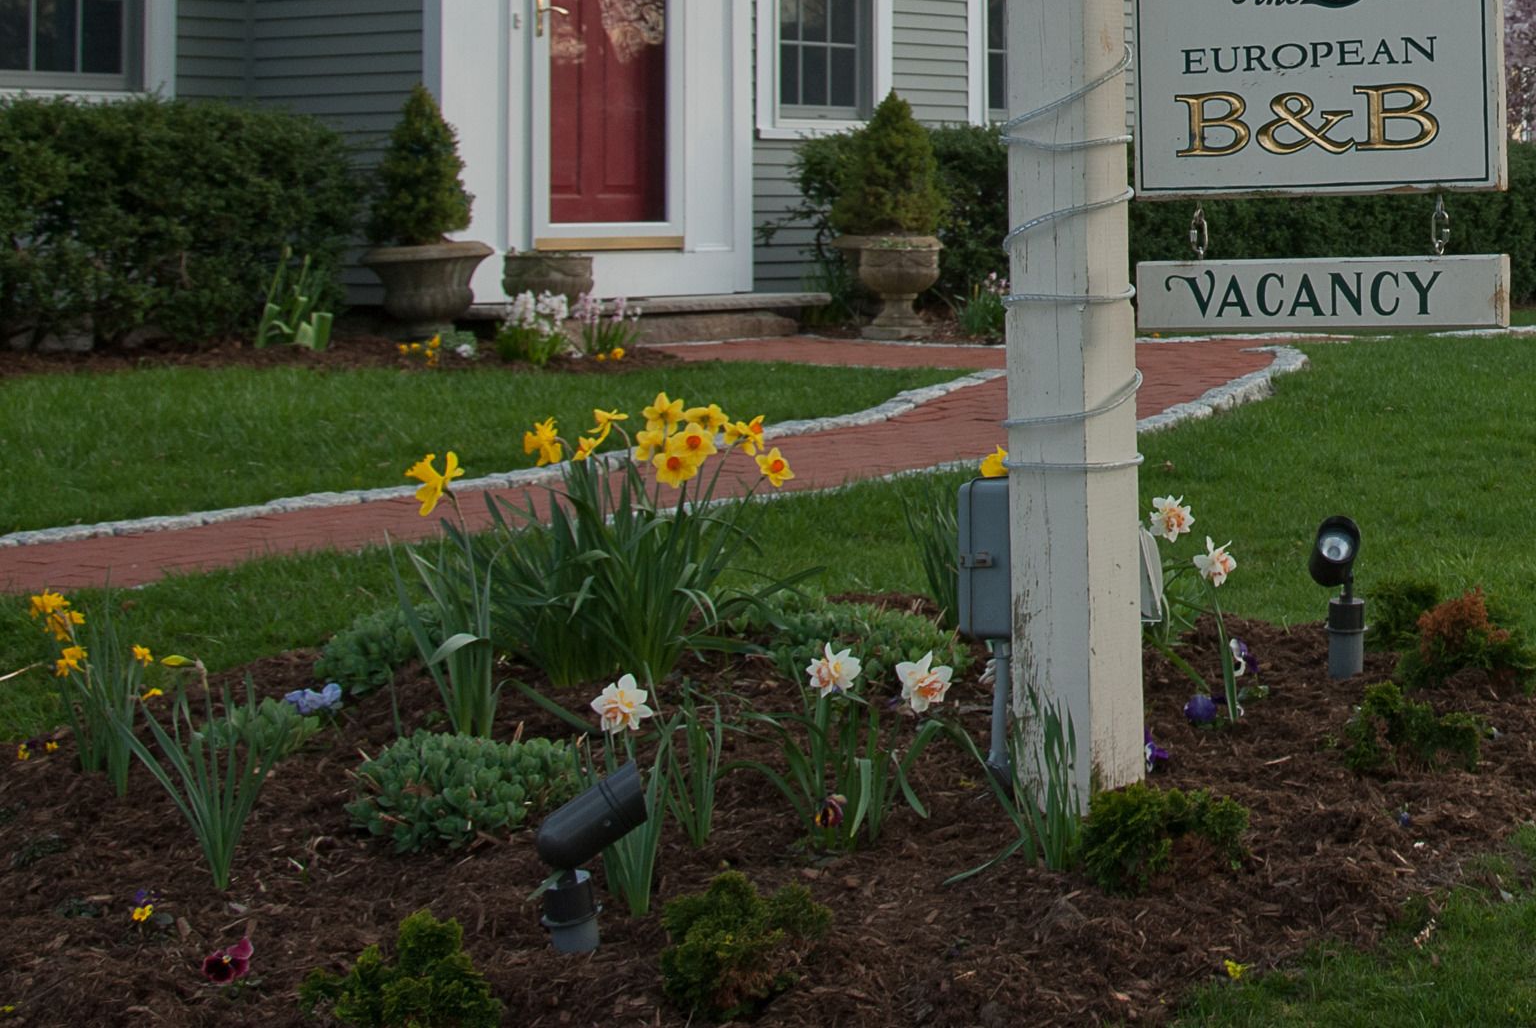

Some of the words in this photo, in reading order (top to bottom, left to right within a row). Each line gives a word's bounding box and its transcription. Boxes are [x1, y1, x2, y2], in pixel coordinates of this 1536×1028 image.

[1181, 35, 1438, 75] EUROPEAN
[1174, 82, 1440, 157] B&B
[1164, 269, 1443, 318] VACANCY
